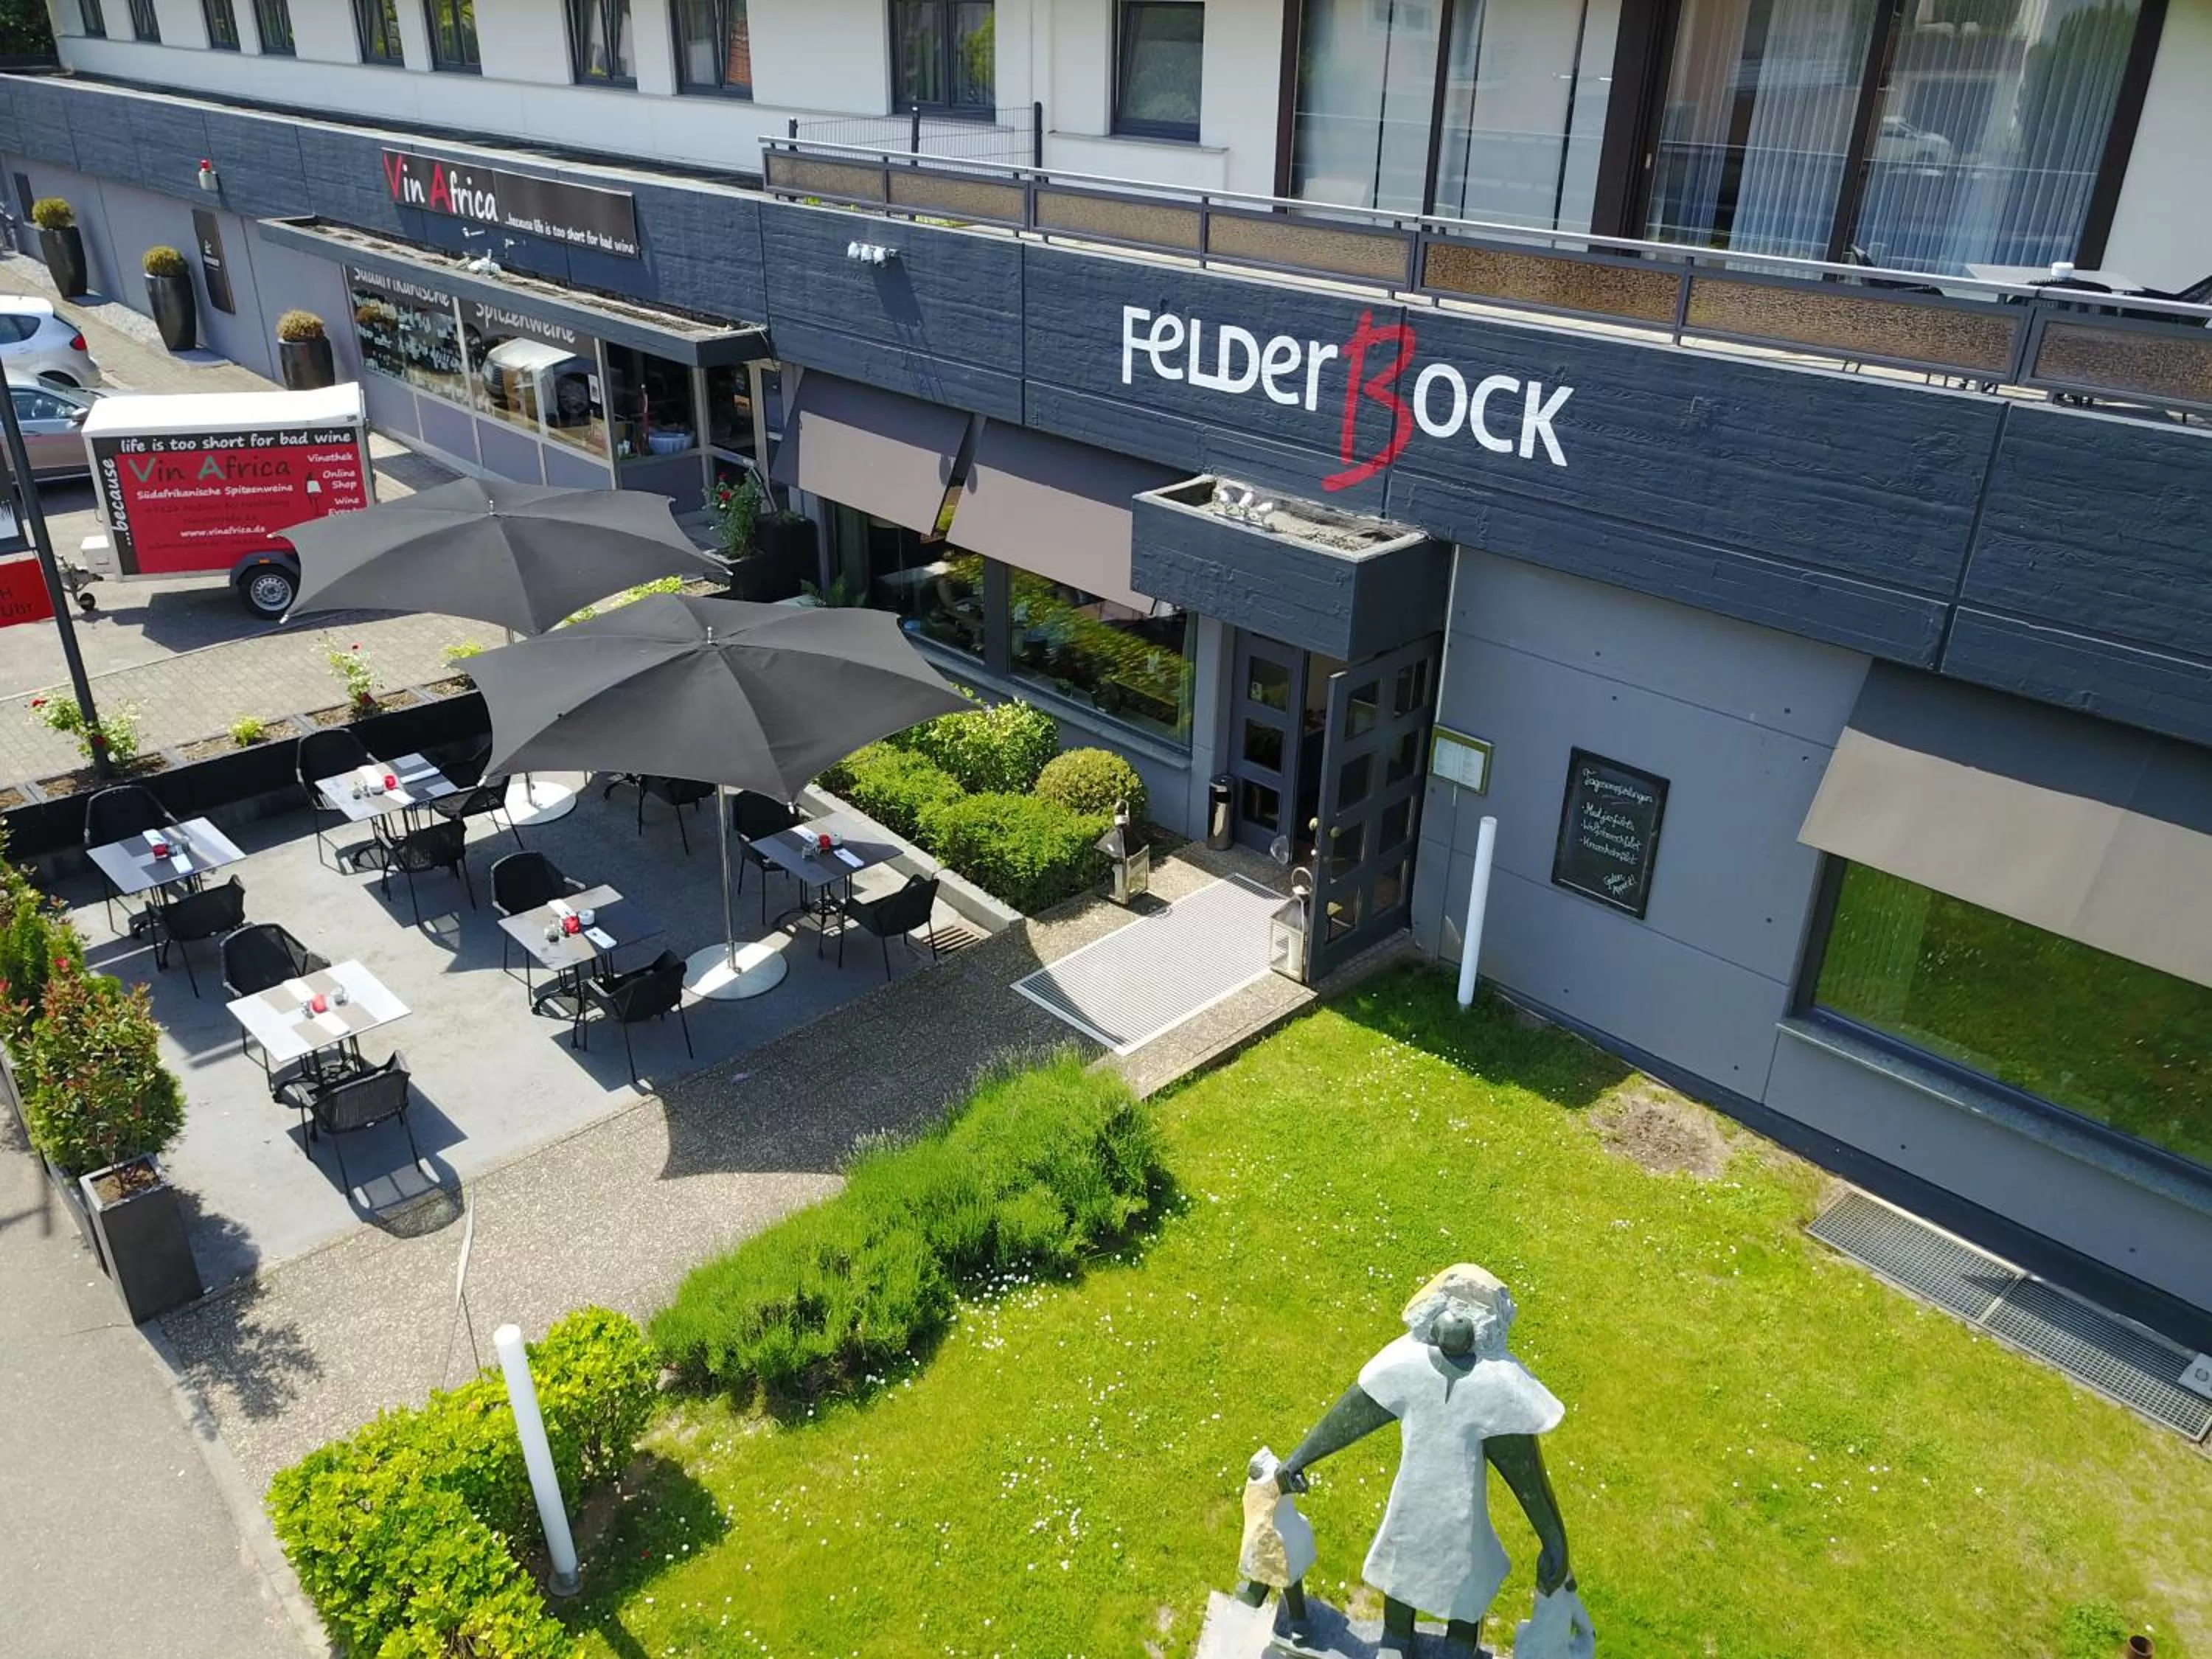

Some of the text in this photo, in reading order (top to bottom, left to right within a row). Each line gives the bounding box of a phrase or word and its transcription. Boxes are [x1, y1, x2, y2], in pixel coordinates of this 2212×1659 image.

[383, 152, 498, 222] Vin Africa
[534, 219, 544, 234] life
[545, 221, 552, 236] is
[553, 225, 566, 238] too
[567, 227, 585, 243] short
[587, 229, 598, 246] for
[599, 233, 613, 249] bad
[614, 239, 635, 254] wine
[121, 430, 352, 453] life is too short for bad wine
[307, 452, 354, 463] Vinothek
[128, 455, 291, 482] Vin Africa
[322, 468, 355, 479] Online
[136, 484, 293, 500] Südafrikanische Spitzenweine
[332, 480, 358, 491] Shop
[181, 525, 266, 538] www.vinafrica.de
